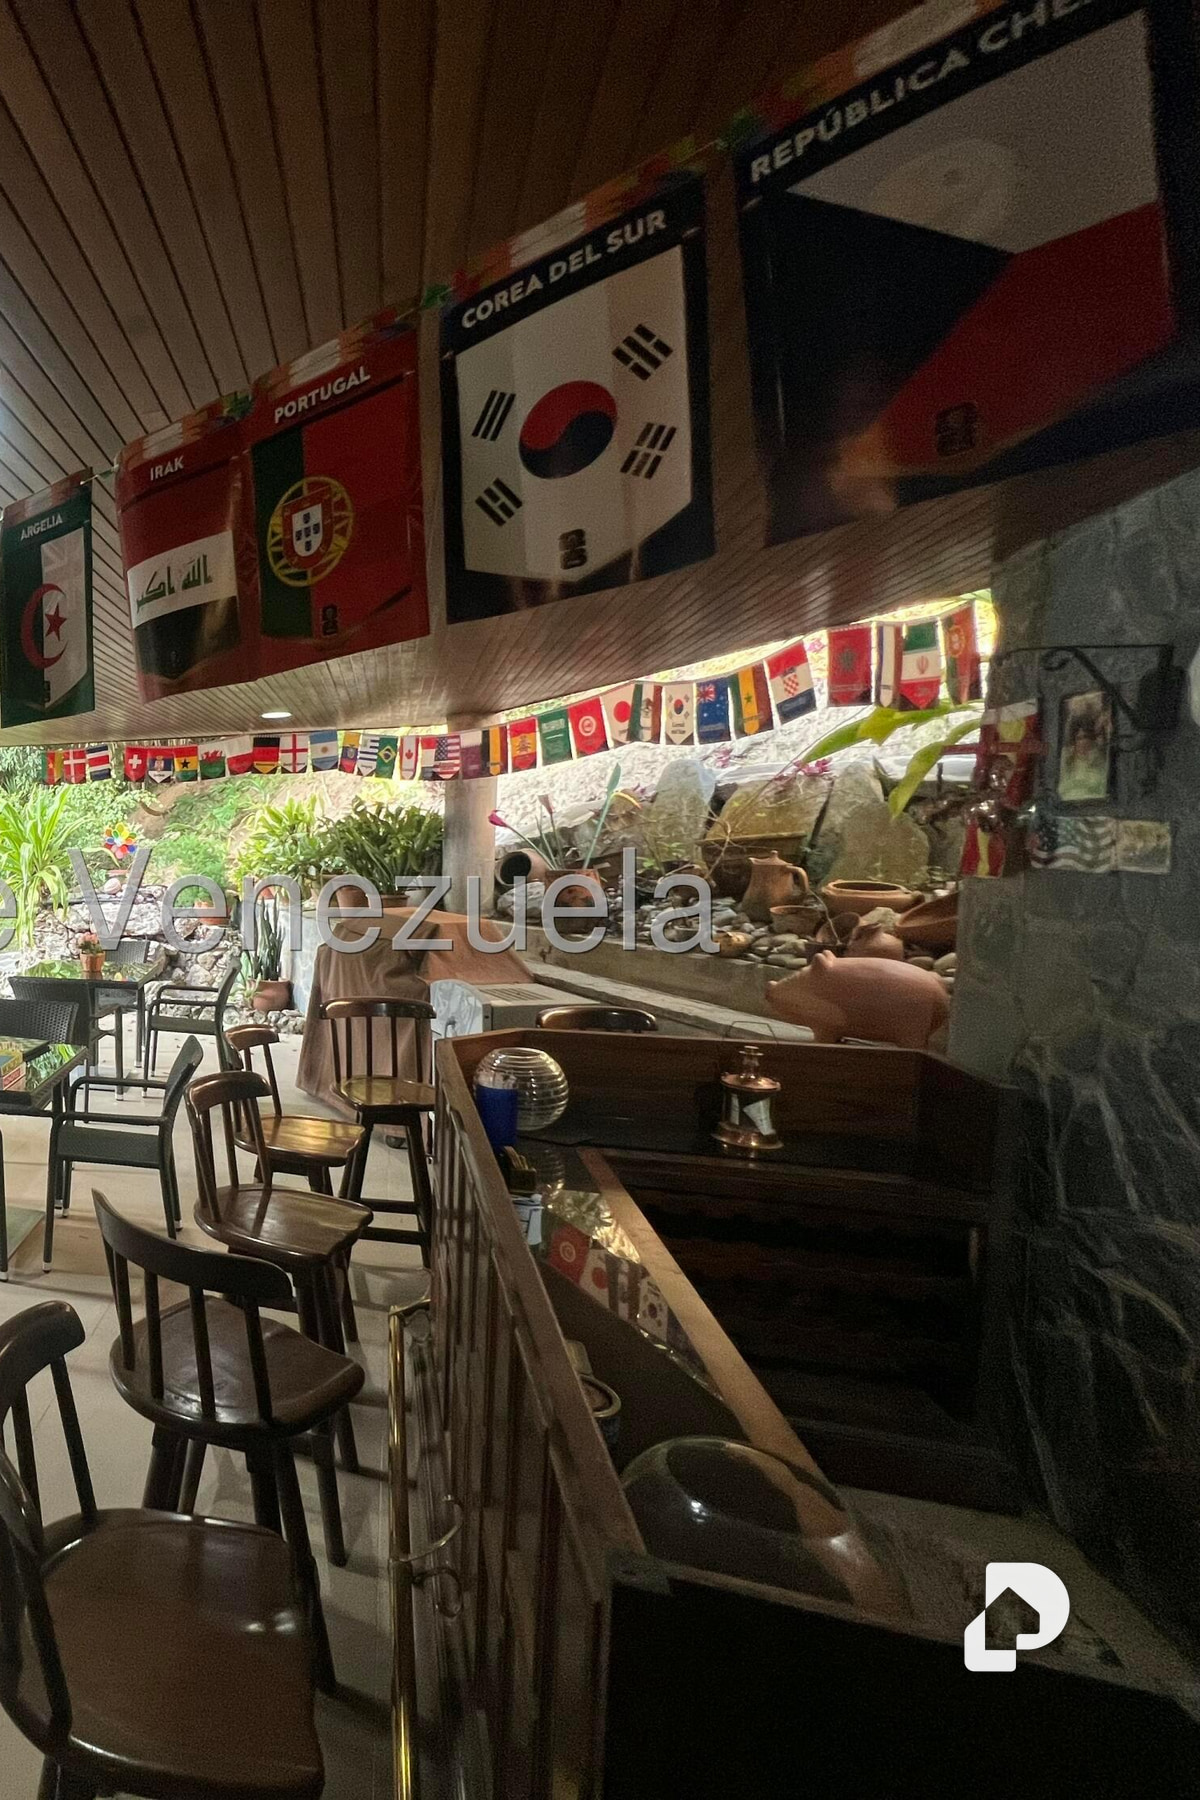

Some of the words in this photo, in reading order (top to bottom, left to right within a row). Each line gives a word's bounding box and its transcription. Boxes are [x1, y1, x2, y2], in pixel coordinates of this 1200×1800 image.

[751, 48, 970, 183] REPÚBLICA
[462, 274, 543, 328] COREA
[550, 244, 602, 283] DEL
[606, 209, 666, 253] SUR
[274, 366, 371, 424] PORTUGAL
[150, 455, 184, 481] IRAK
[20, 513, 63, 541] ARGELIA
